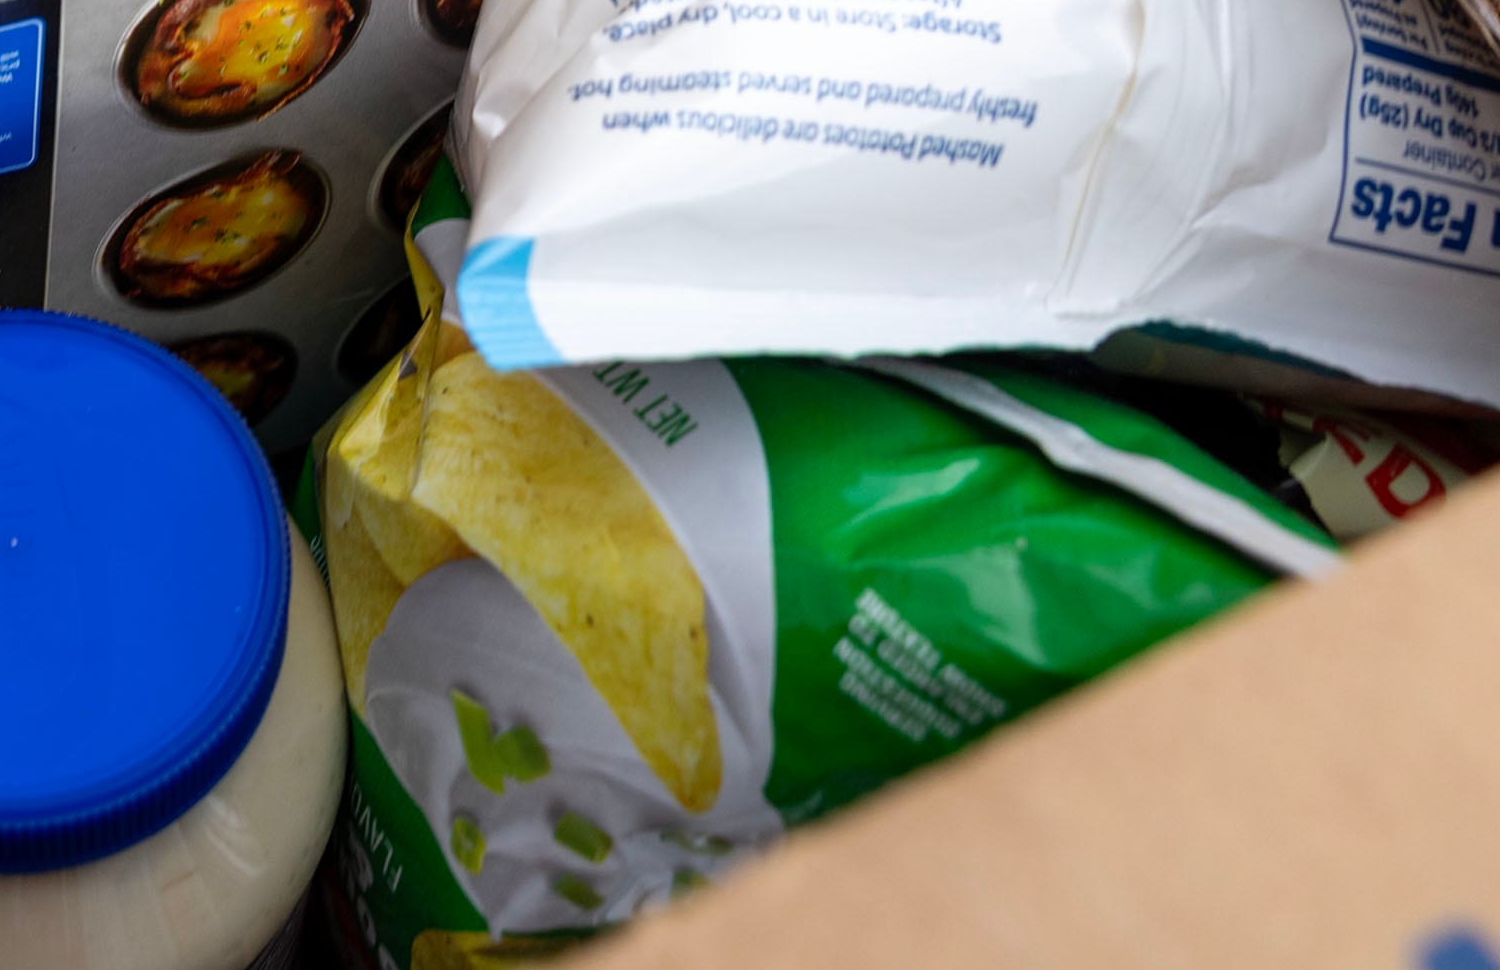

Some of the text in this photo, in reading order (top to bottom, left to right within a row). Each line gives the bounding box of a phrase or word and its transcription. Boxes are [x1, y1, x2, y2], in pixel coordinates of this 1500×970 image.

[601, 14, 674, 42] place.
[676, 5, 719, 26] dry
[835, 9, 898, 34] Store
[907, 11, 1002, 44] Storage:
[567, 71, 1038, 128] freshly prepared and served steaming hot.
[1363, 67, 1442, 105] Prepared
[1359, 95, 1410, 129] (25g)
[1414, 108, 1444, 138] Dry
[602, 110, 1003, 167] Mashed Potatoes are delicious when
[1405, 143, 1490, 184] Container
[1353, 180, 1477, 254] Facts
[592, 361, 696, 445] NET WT
